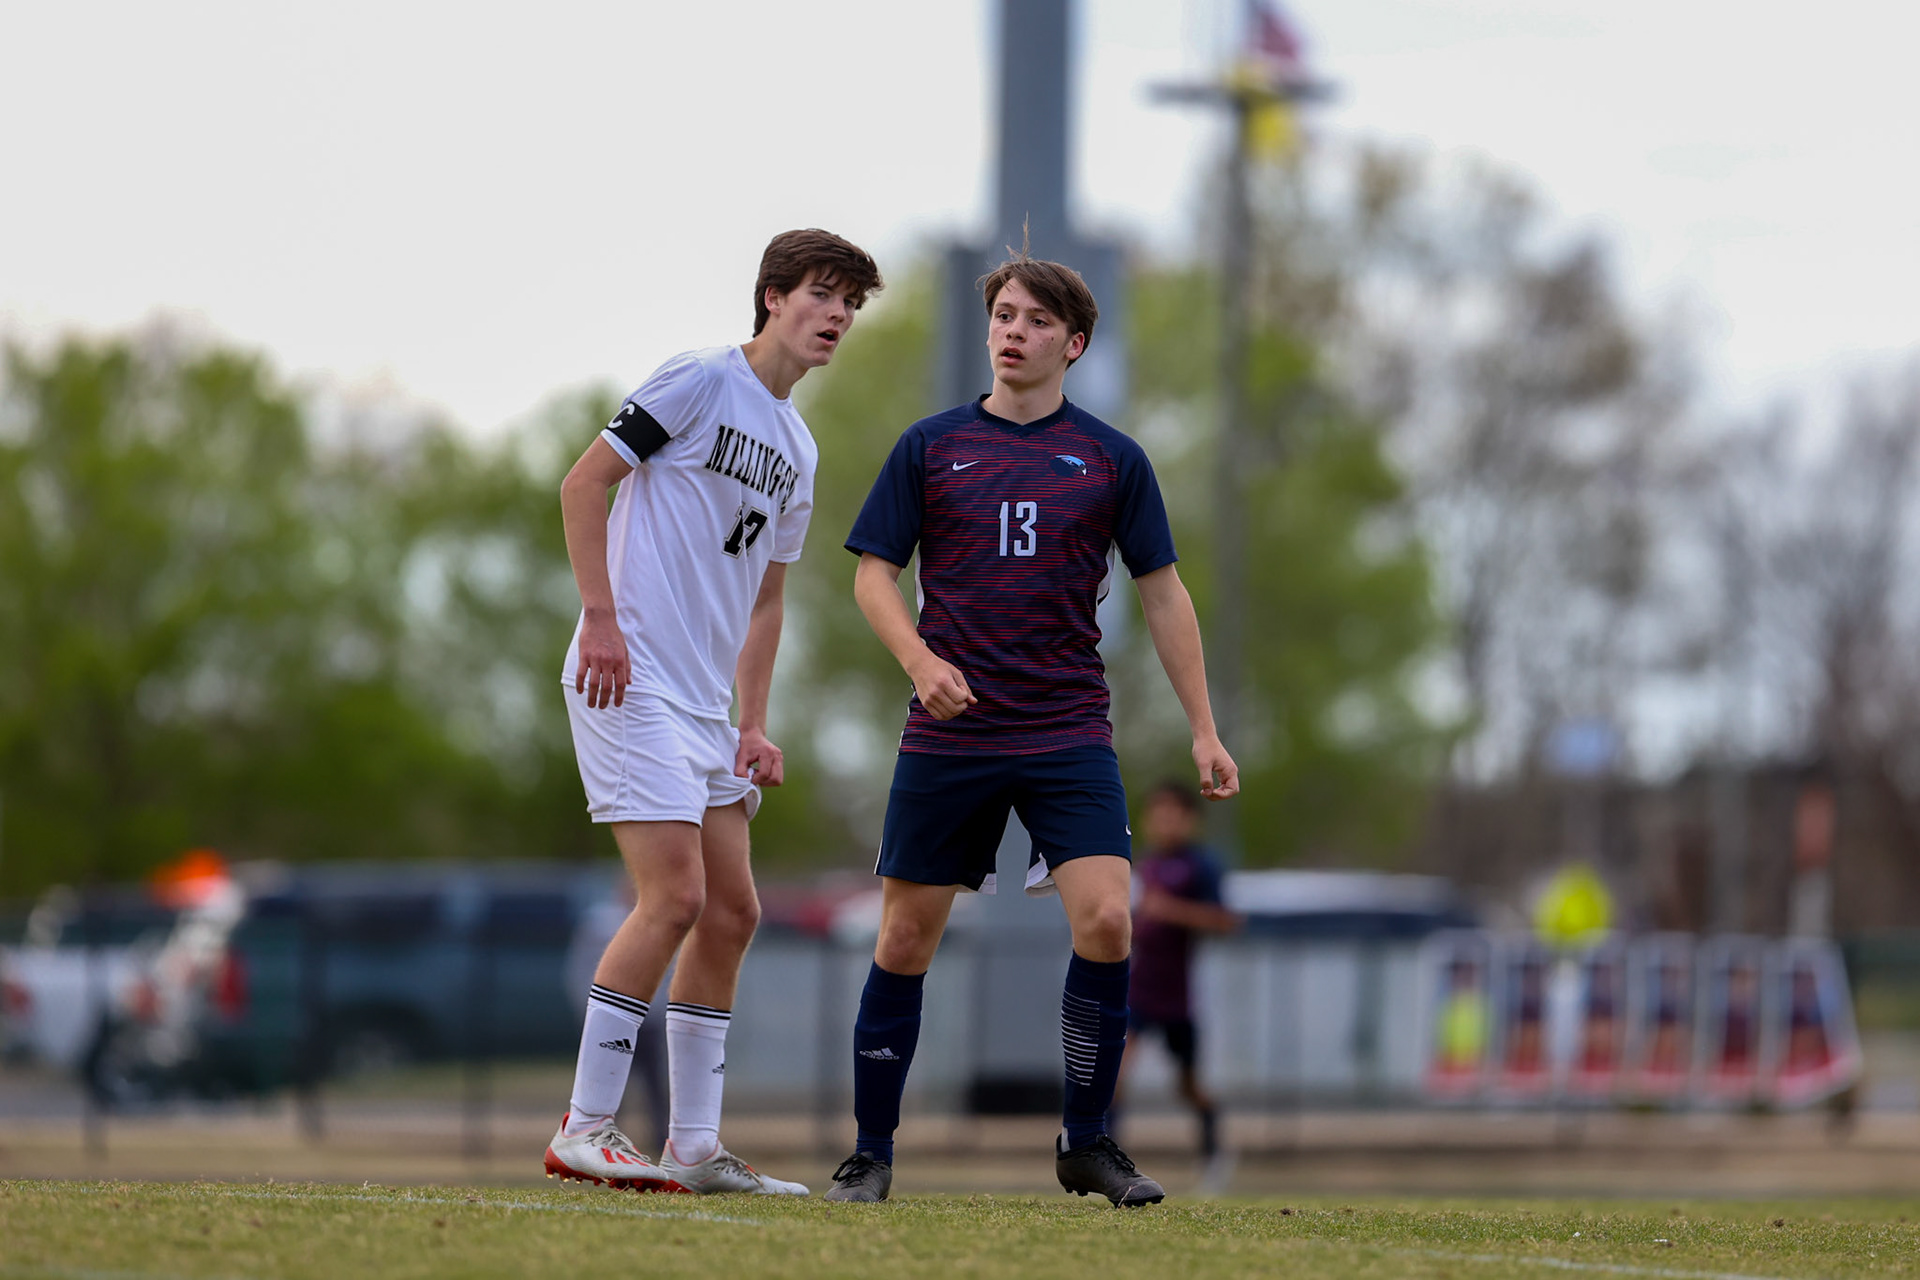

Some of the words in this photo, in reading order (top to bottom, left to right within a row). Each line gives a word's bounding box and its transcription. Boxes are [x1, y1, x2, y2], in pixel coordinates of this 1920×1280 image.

[607, 402, 635, 429] C
[704, 424, 799, 515] MILLING
[721, 503, 769, 559] 17
[999, 501, 1037, 556] 13
[599, 1042, 634, 1055] adidas
[859, 1050, 900, 1060] adidas
